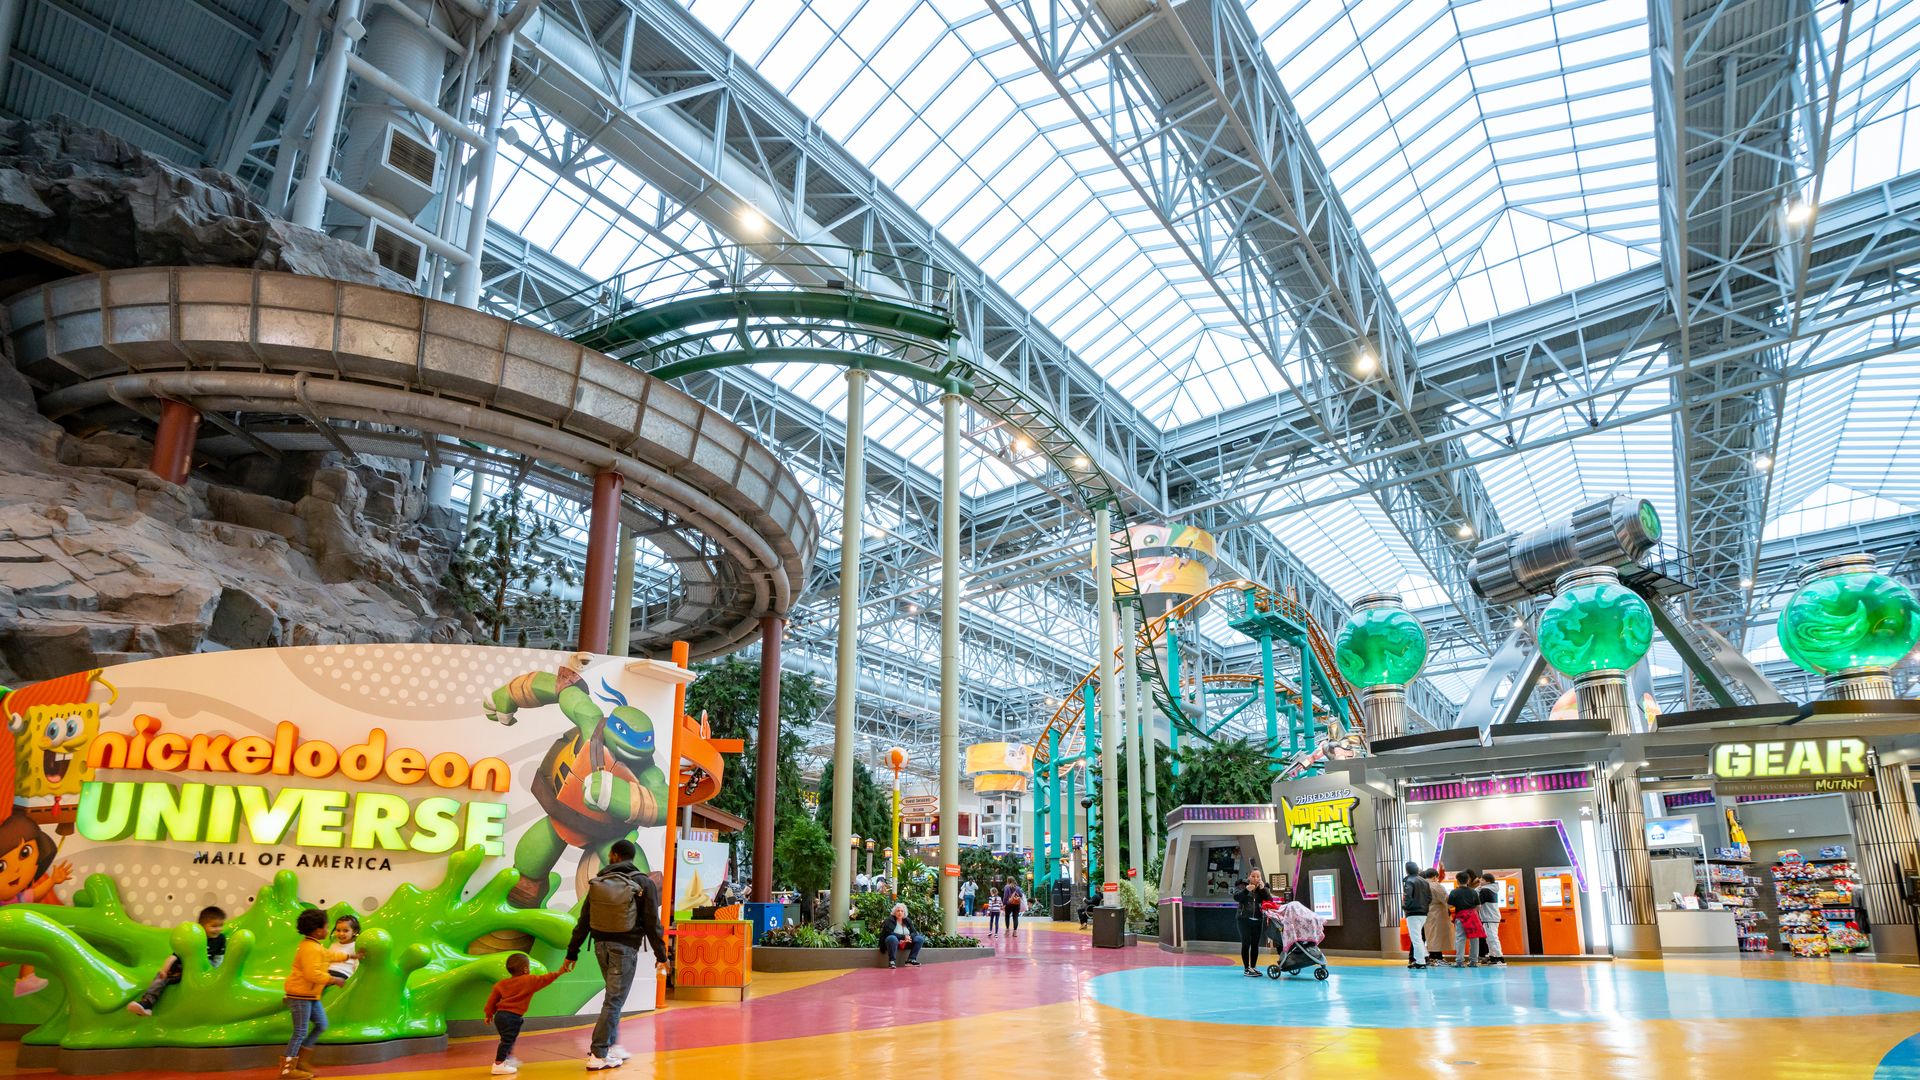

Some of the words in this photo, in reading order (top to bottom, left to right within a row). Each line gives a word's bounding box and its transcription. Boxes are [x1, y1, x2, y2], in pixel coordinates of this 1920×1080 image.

[88, 714, 511, 792] nickelodeon
[1715, 739, 1866, 778] GEAR
[1295, 788, 1351, 805] SHREDDER'S
[1815, 778, 1866, 791] MUTANT
[76, 781, 507, 856] UNIVERSE
[1281, 796, 1357, 836] MUTANT
[1290, 821, 1355, 850] MASHER
[193, 851, 247, 865] MALL
[258, 852, 286, 866] OF
[296, 853, 392, 871] AMERICA
